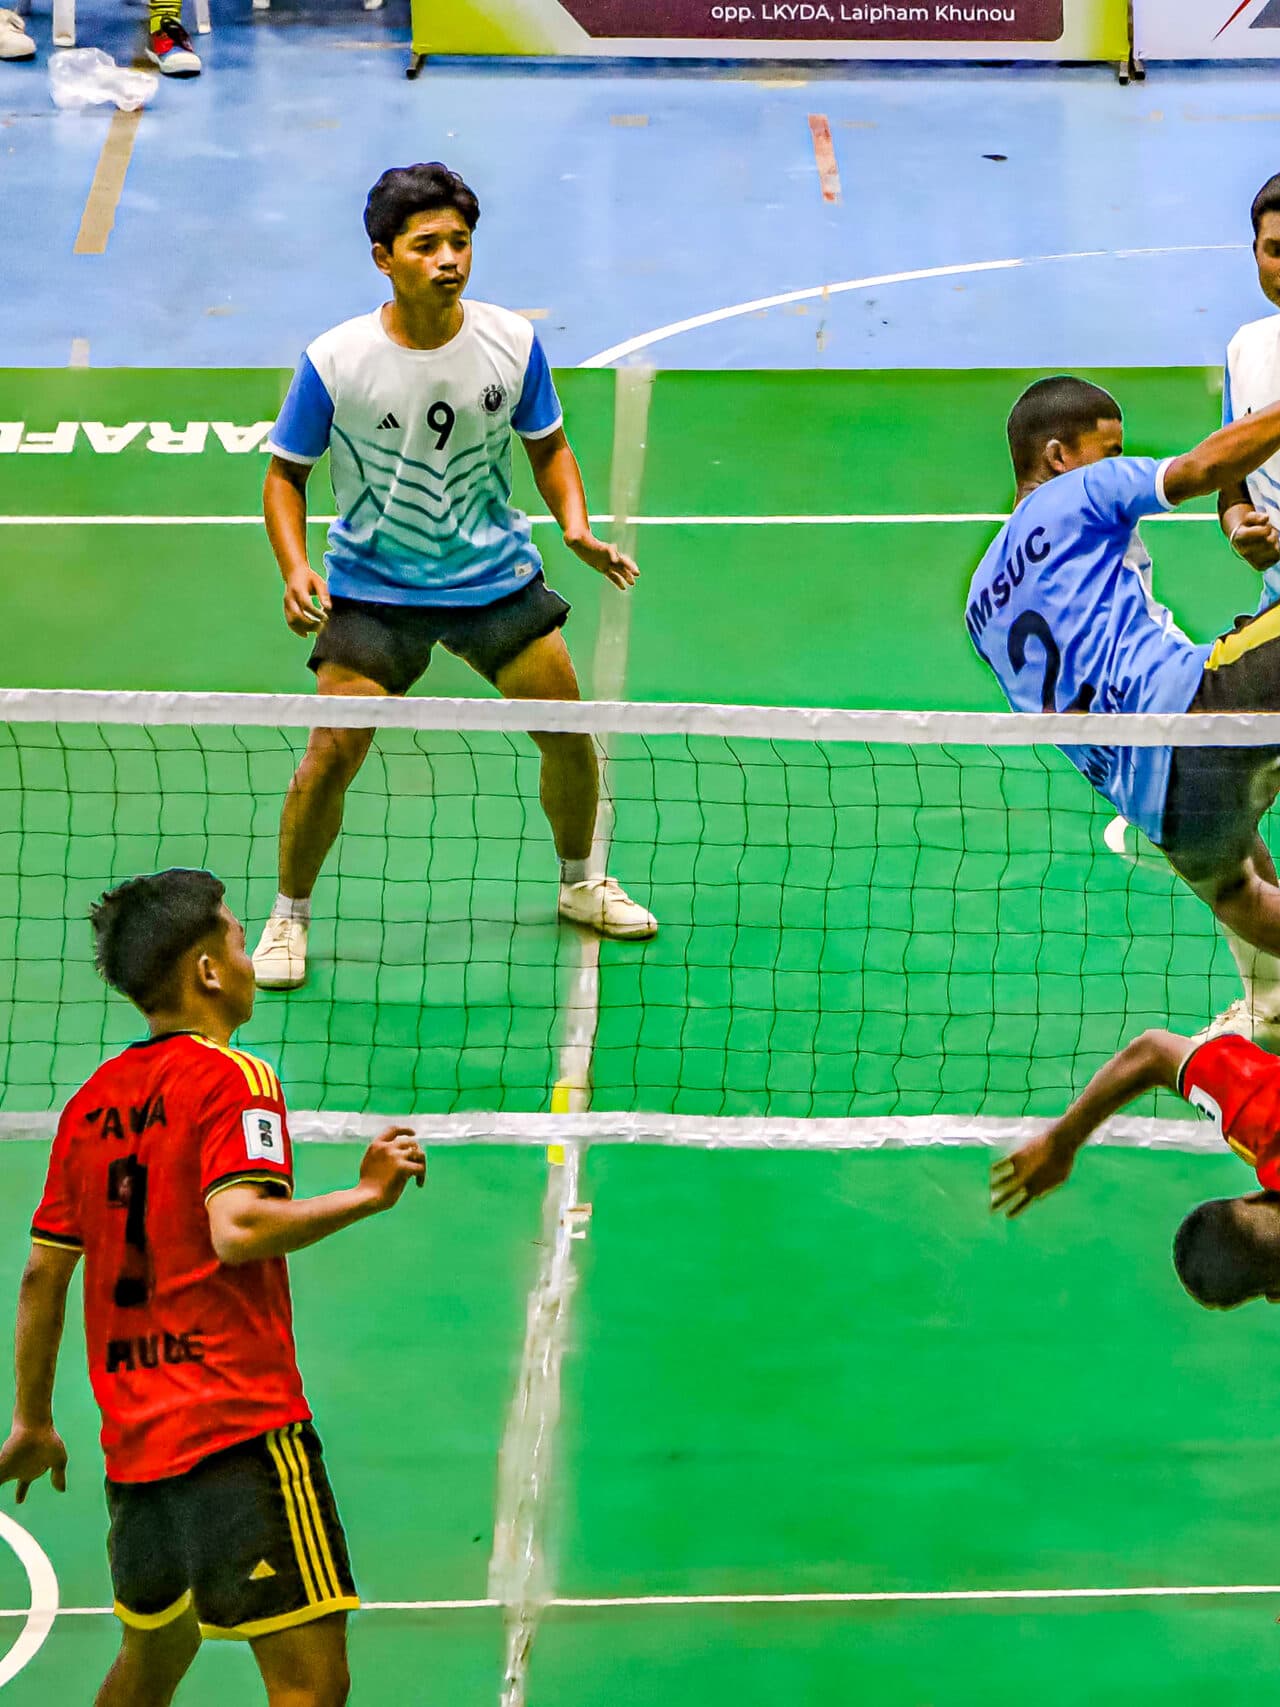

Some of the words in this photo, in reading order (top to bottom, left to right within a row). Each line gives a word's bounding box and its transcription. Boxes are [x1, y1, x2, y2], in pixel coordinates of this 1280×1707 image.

[711, 5, 755, 22] opp.
[762, 4, 834, 23] LKYDA,
[840, 4, 928, 24] Laipham
[936, 4, 1016, 22] Khunou
[427, 401, 455, 451] 9
